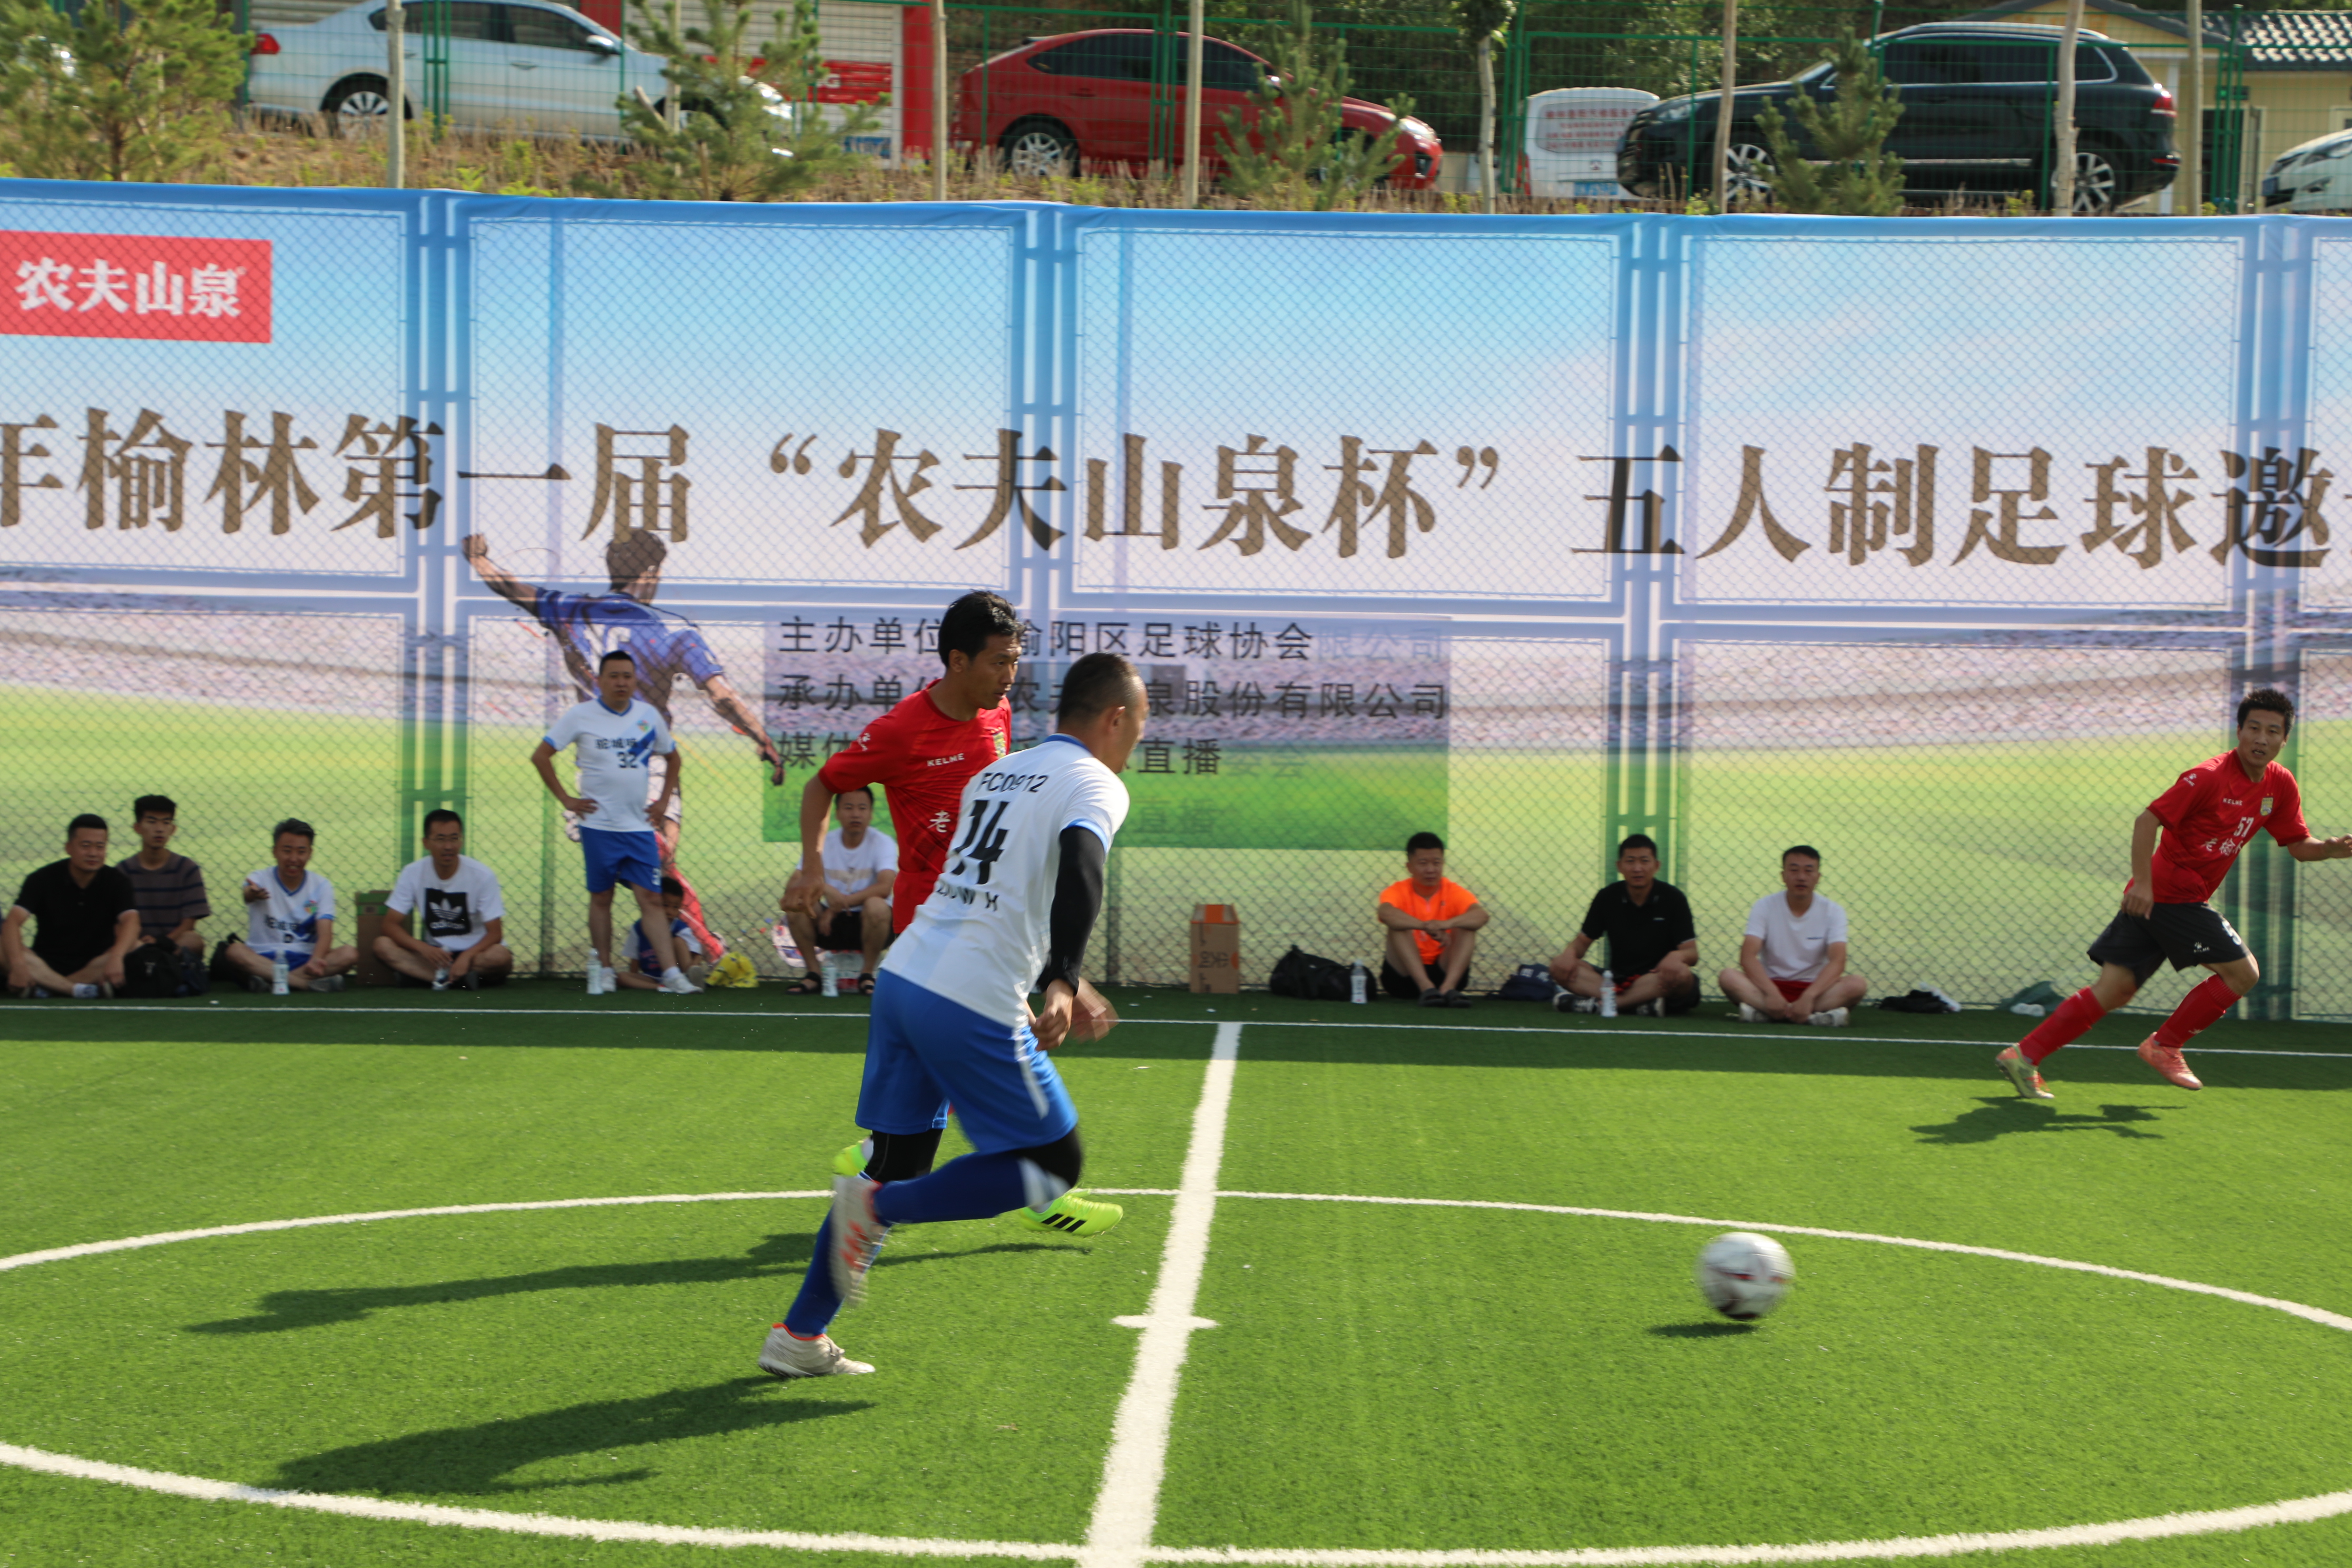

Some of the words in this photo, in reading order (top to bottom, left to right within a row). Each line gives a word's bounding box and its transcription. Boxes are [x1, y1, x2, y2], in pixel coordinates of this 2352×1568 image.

[15, 257, 241, 318] 农夫山泉
[0, 407, 2352, 569] 年榆林第一届“农夫山泉杯”五人制足球邀
[927, 752, 965, 767] KELME
[1138, 738, 1222, 775] 直播
[977, 772, 1049, 793] FC0912
[949, 799, 1011, 885] 14
[2233, 817, 2254, 838] 57
